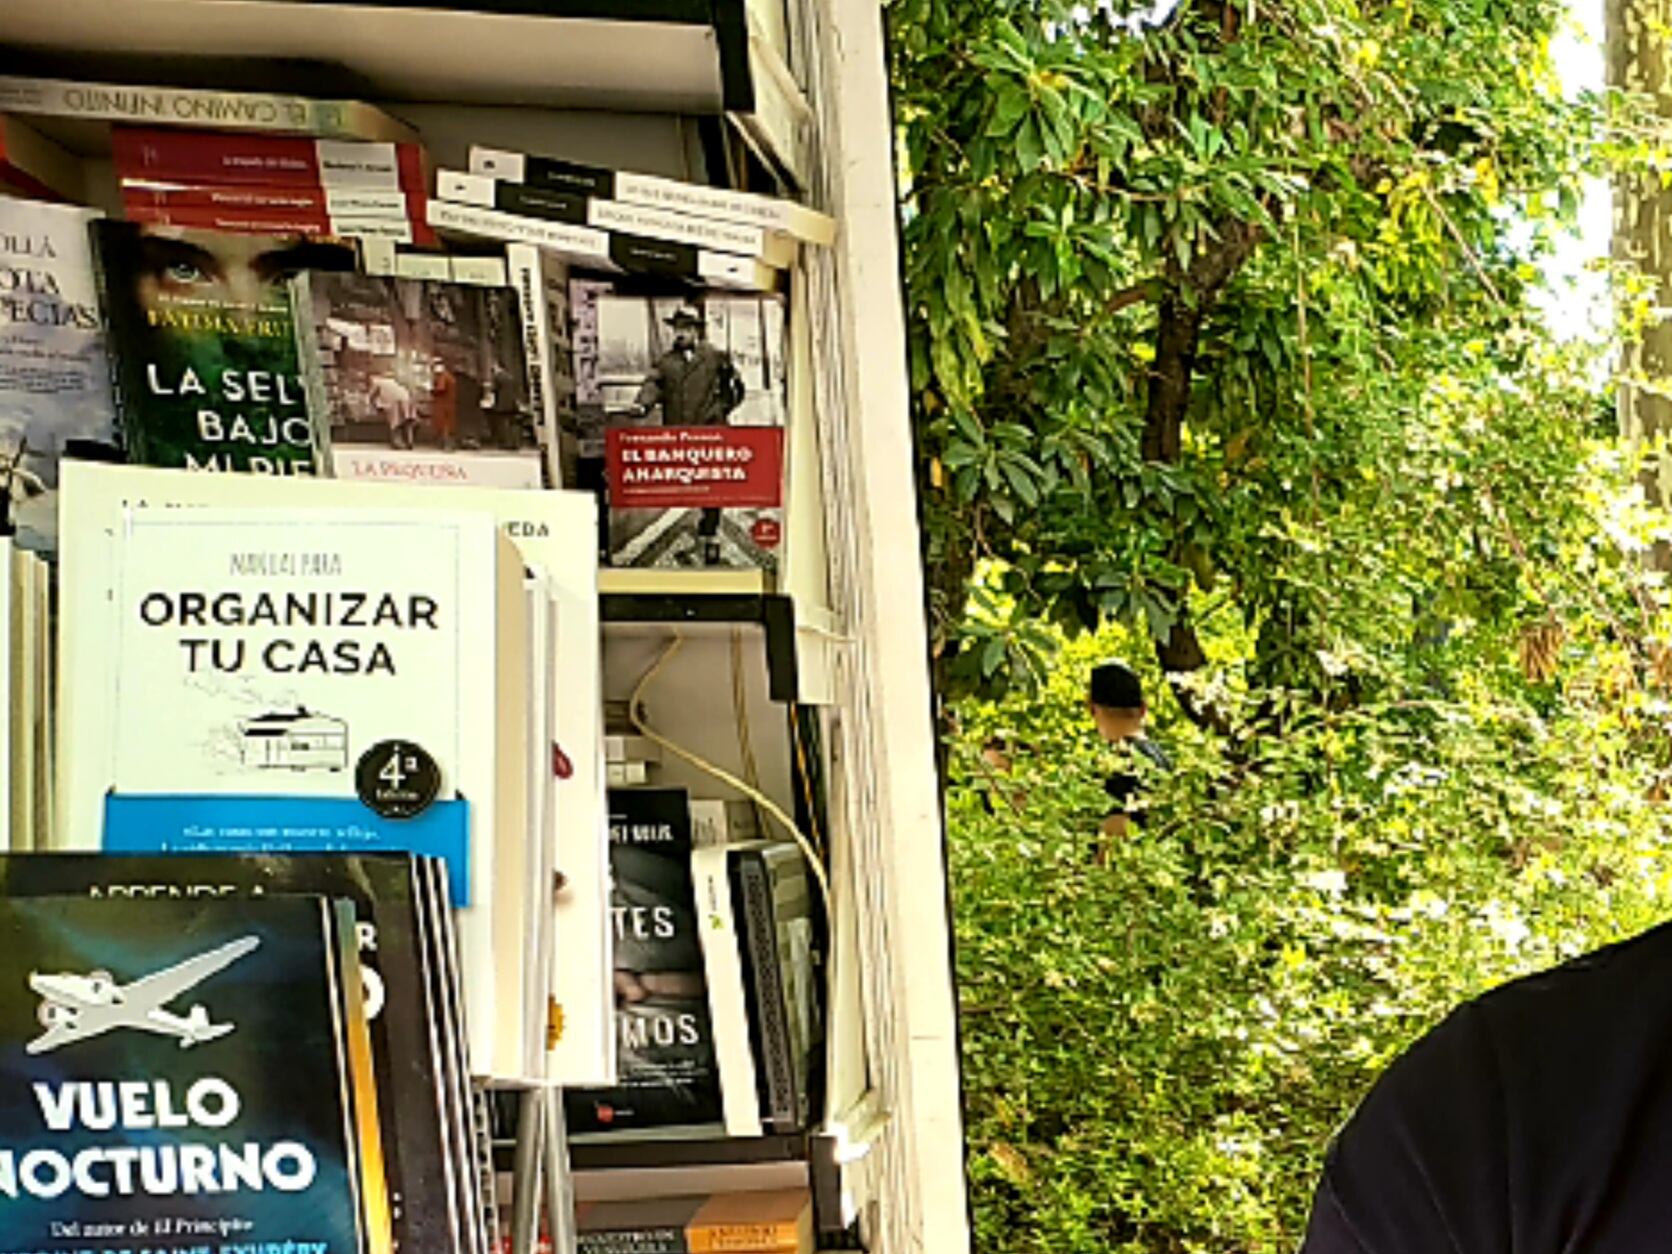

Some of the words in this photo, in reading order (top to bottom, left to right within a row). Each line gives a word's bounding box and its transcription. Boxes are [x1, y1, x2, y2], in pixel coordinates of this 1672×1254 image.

[63, 88, 163, 114] INFINITO
[175, 97, 281, 124] CAMINO
[147, 363, 207, 396] LA
[221, 369, 305, 406] SEL
[198, 409, 312, 446] BAJO
[622, 448, 642, 463] EL
[644, 447, 753, 466] BANQUERO
[622, 466, 747, 484] ANARQUISTA
[139, 591, 440, 630] ORGANIZAR
[179, 638, 247, 673] TU
[262, 640, 397, 677] CASA
[33, 1077, 241, 1131] VUELO
